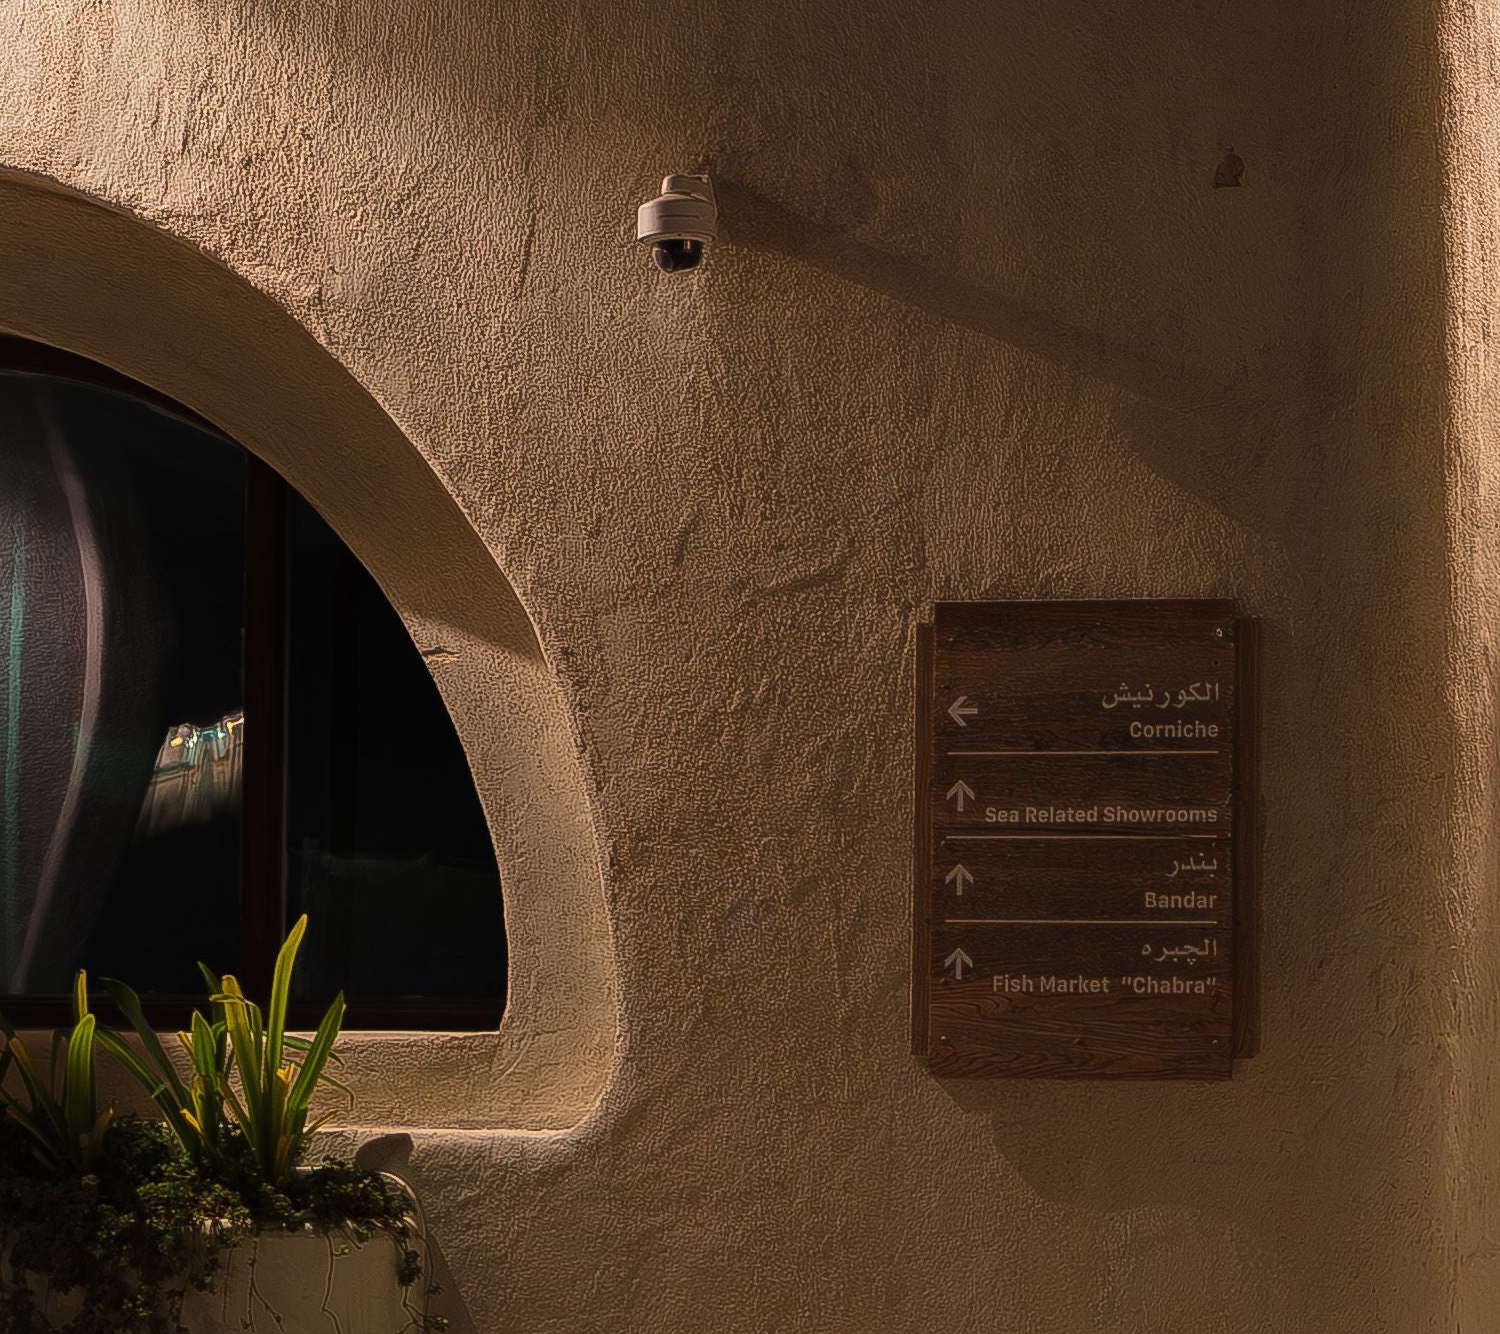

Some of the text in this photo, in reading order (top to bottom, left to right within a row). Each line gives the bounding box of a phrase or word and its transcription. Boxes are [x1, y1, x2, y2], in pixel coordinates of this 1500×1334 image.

[1101, 682, 1219, 708] الكورنيش
[1129, 720, 1219, 738] Corniche
[985, 806, 1217, 822] Sea Related Showrooms
[1164, 852, 1217, 878] بندر
[1145, 891, 1218, 908] Bandar
[992, 974, 1033, 992] Fish
[1040, 975, 1110, 993] Market
